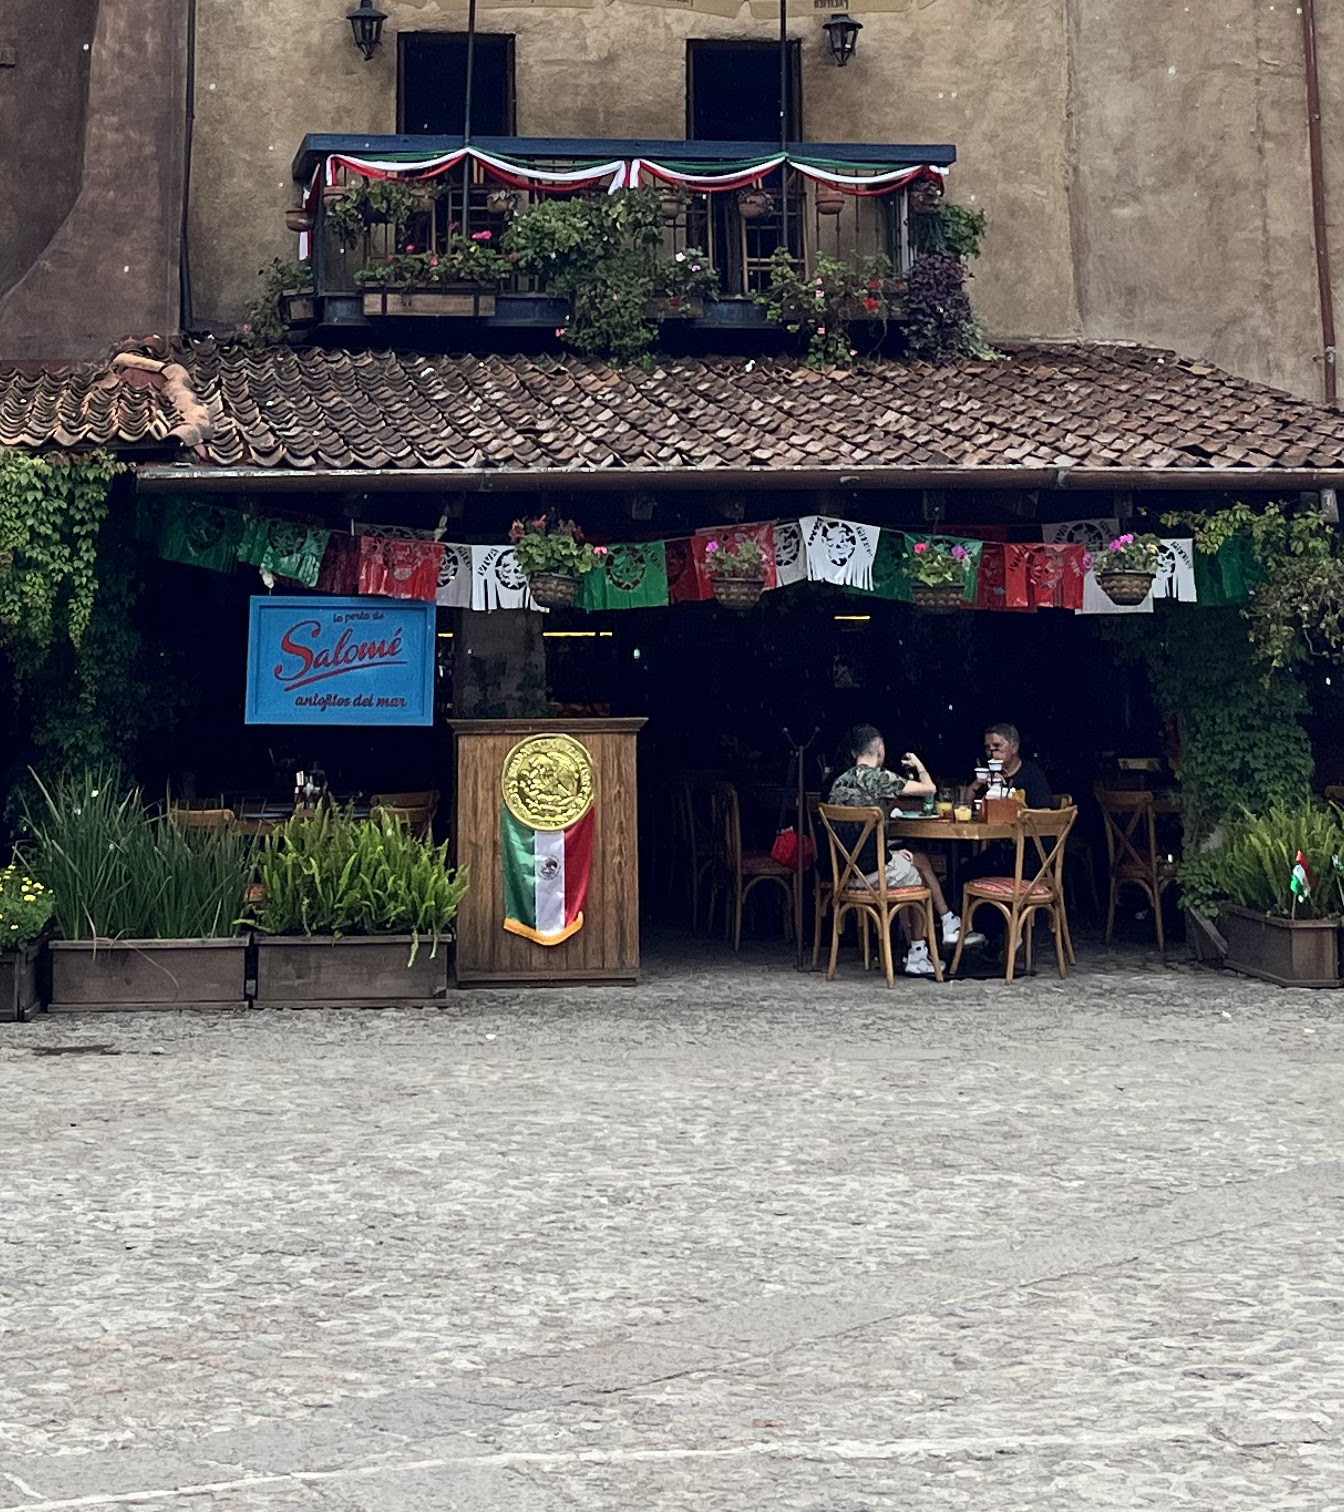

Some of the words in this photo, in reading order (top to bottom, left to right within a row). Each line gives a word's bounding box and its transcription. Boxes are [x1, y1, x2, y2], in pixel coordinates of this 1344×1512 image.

[332, 613, 343, 624] la
[372, 610, 385, 620] de
[274, 619, 404, 681] Salomé
[353, 693, 374, 708] del
[376, 696, 408, 709] mar
